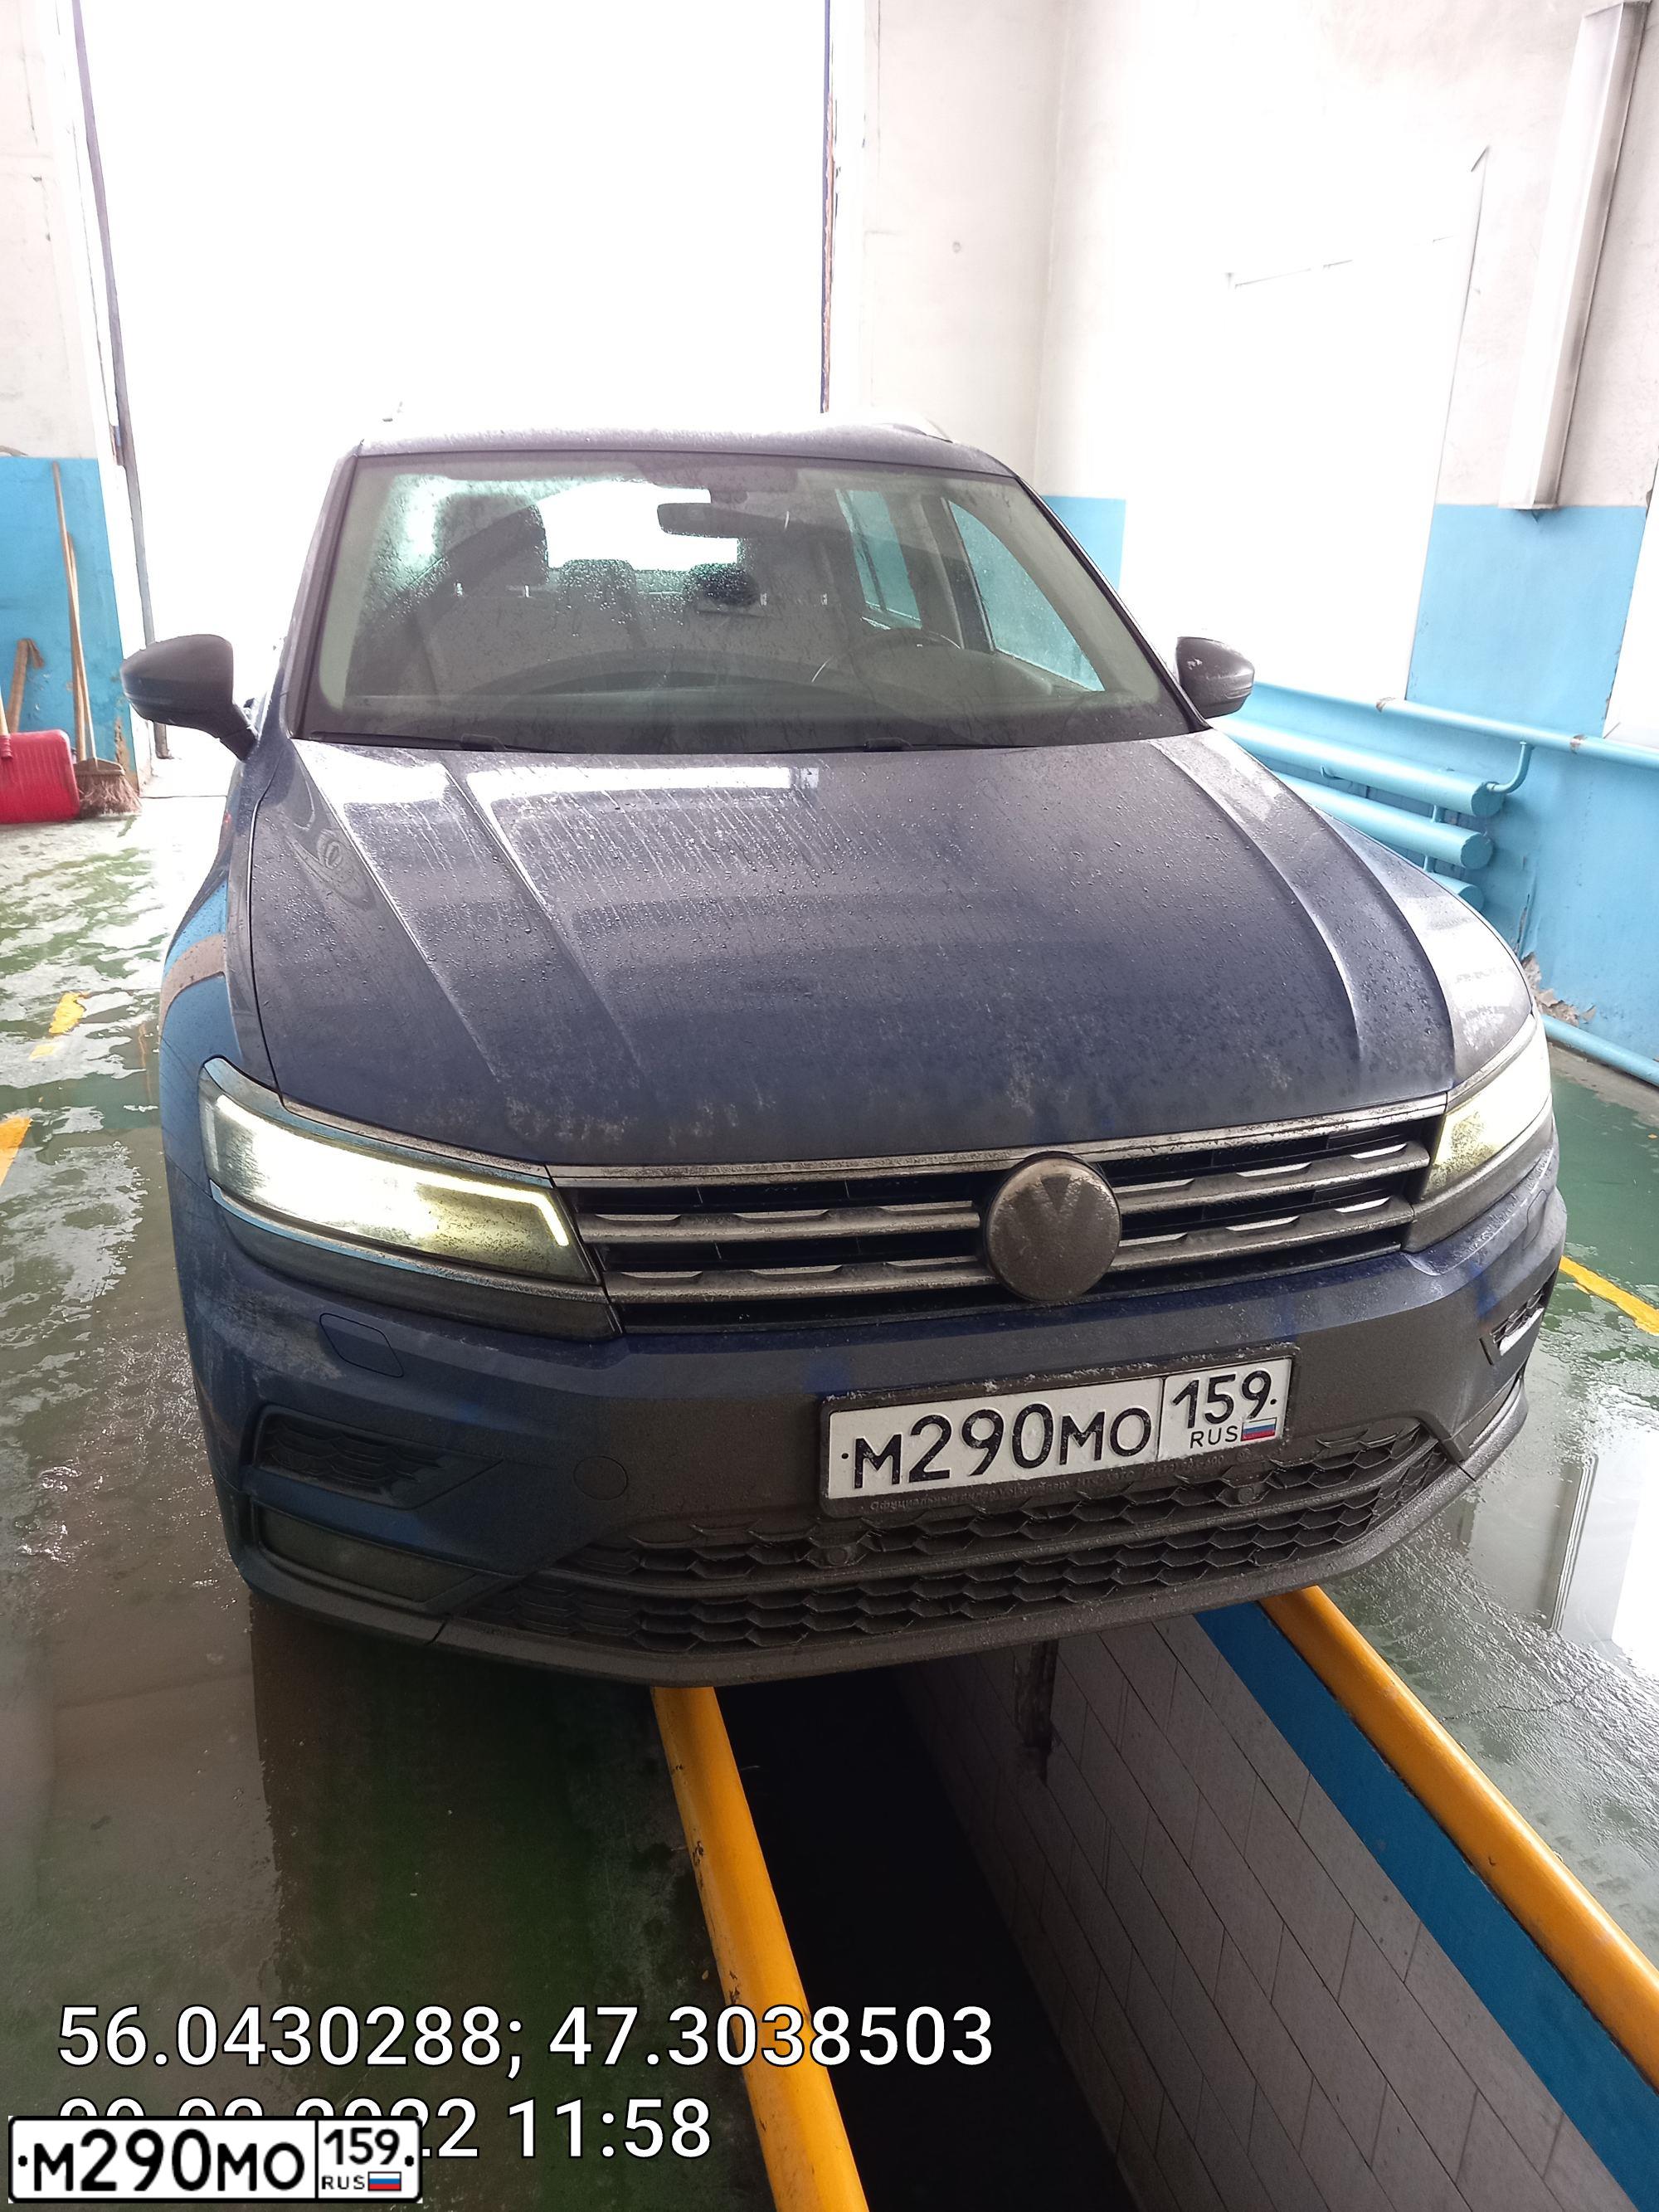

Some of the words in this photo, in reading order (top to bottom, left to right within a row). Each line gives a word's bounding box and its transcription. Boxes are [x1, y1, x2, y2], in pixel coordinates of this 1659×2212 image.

[854, 1402, 1151, 1488] М290МО
[1171, 1370, 1272, 1429] 159
[1190, 1425, 1238, 1449] RUS
